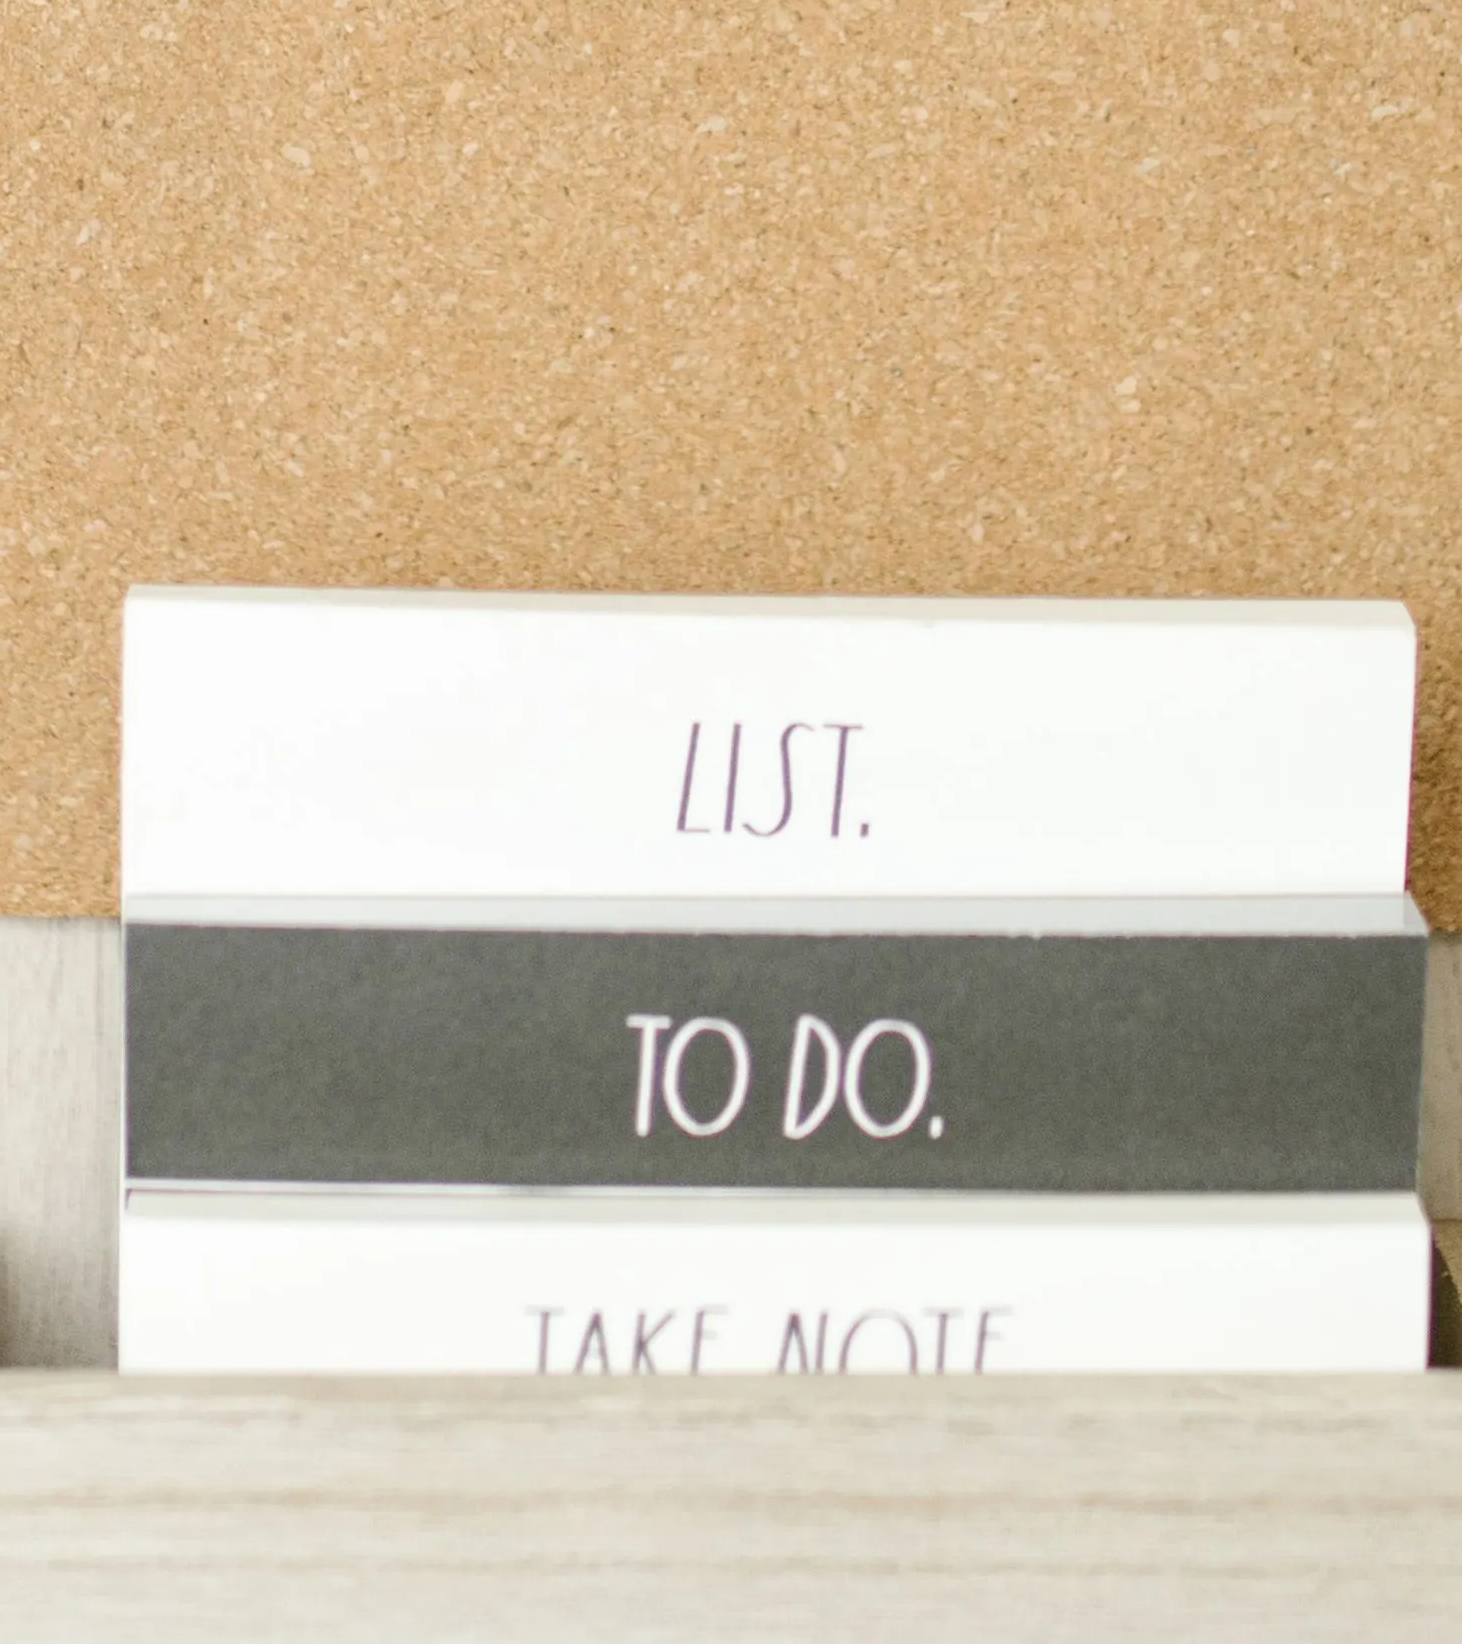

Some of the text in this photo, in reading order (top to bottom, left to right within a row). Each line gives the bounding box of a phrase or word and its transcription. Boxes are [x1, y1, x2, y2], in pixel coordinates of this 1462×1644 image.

[675, 721, 871, 839] LIST.
[625, 1013, 945, 1141] TO DO.
